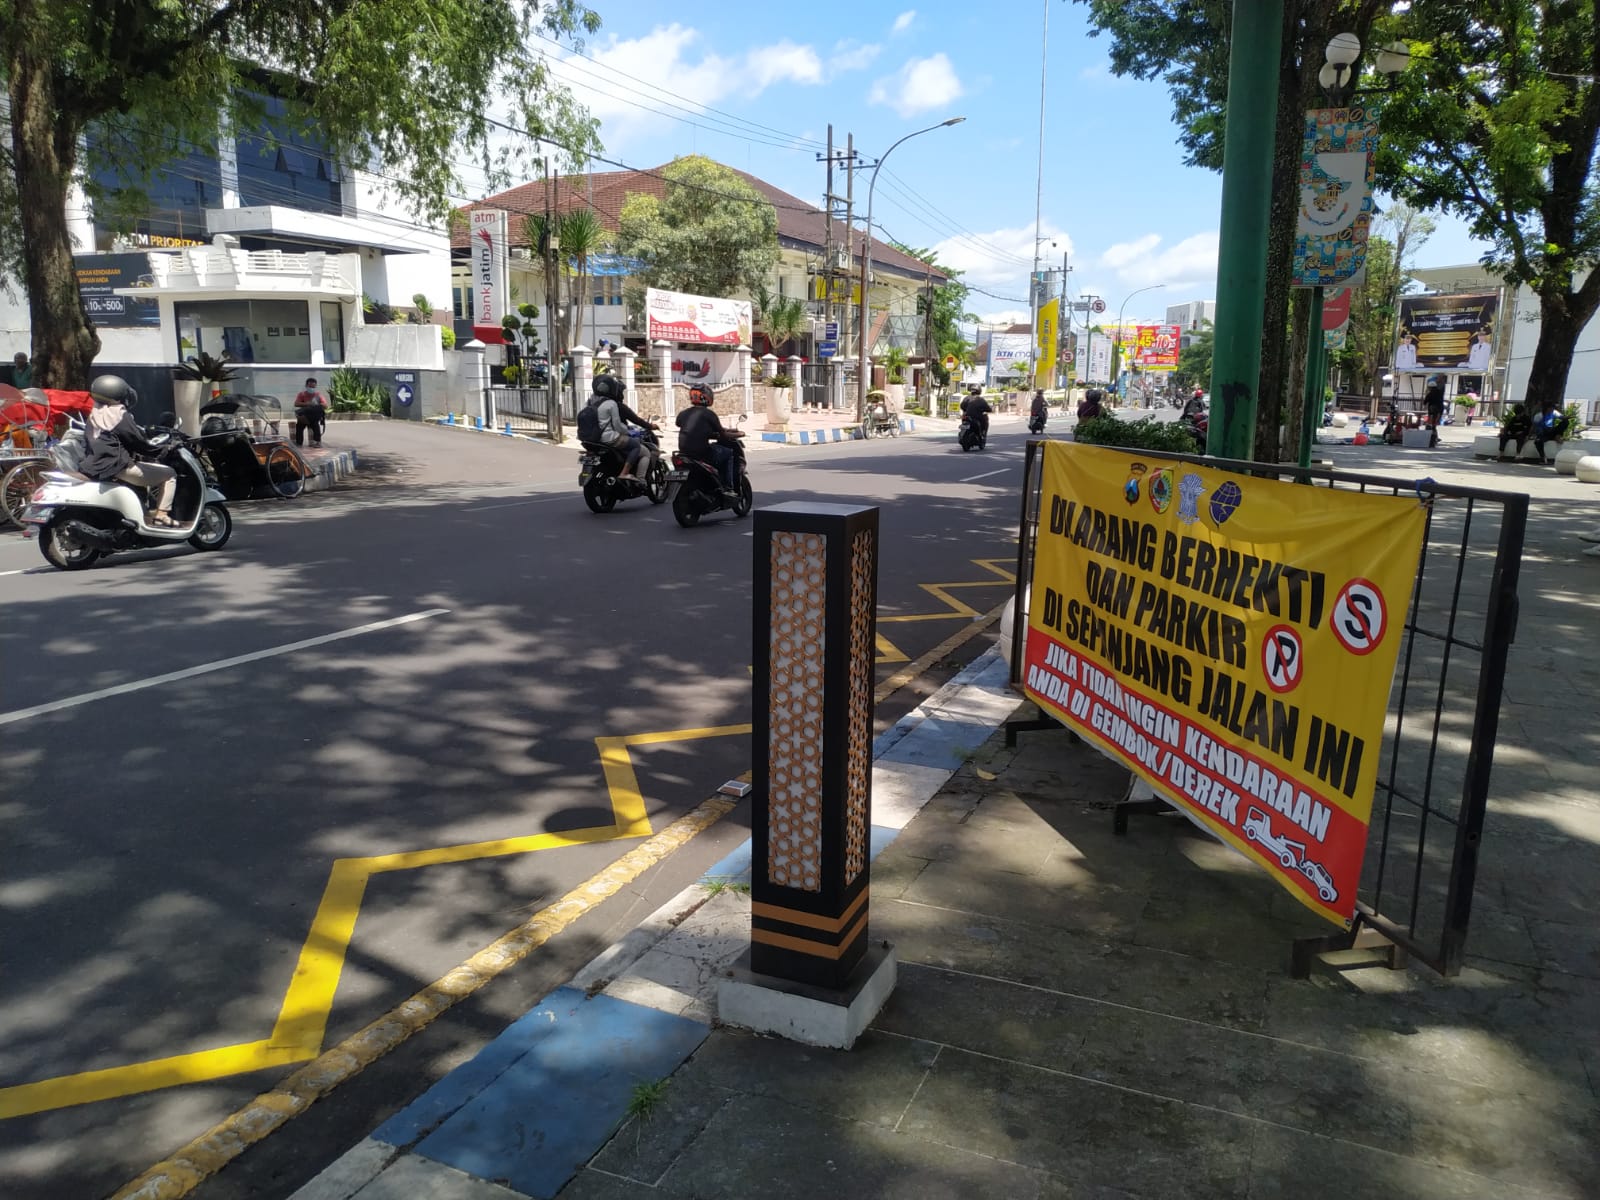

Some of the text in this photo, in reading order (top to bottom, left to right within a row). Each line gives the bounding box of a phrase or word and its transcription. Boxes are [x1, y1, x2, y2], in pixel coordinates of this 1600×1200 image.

[474, 212, 496, 223] atm
[996, 350, 1013, 358] BTN
[1086, 560, 1247, 670] DAN PARKIR
[1161, 530, 1325, 630] BERHENTI
[1027, 664, 1071, 708] ANDA
[1070, 688, 1091, 721] DI
[1043, 587, 1063, 632] DI
[1197, 666, 1299, 762] JALAN
[1303, 715, 1365, 799] INI
[1044, 642, 1332, 844] JIKA TIDAK INGIN KENDARAAN
